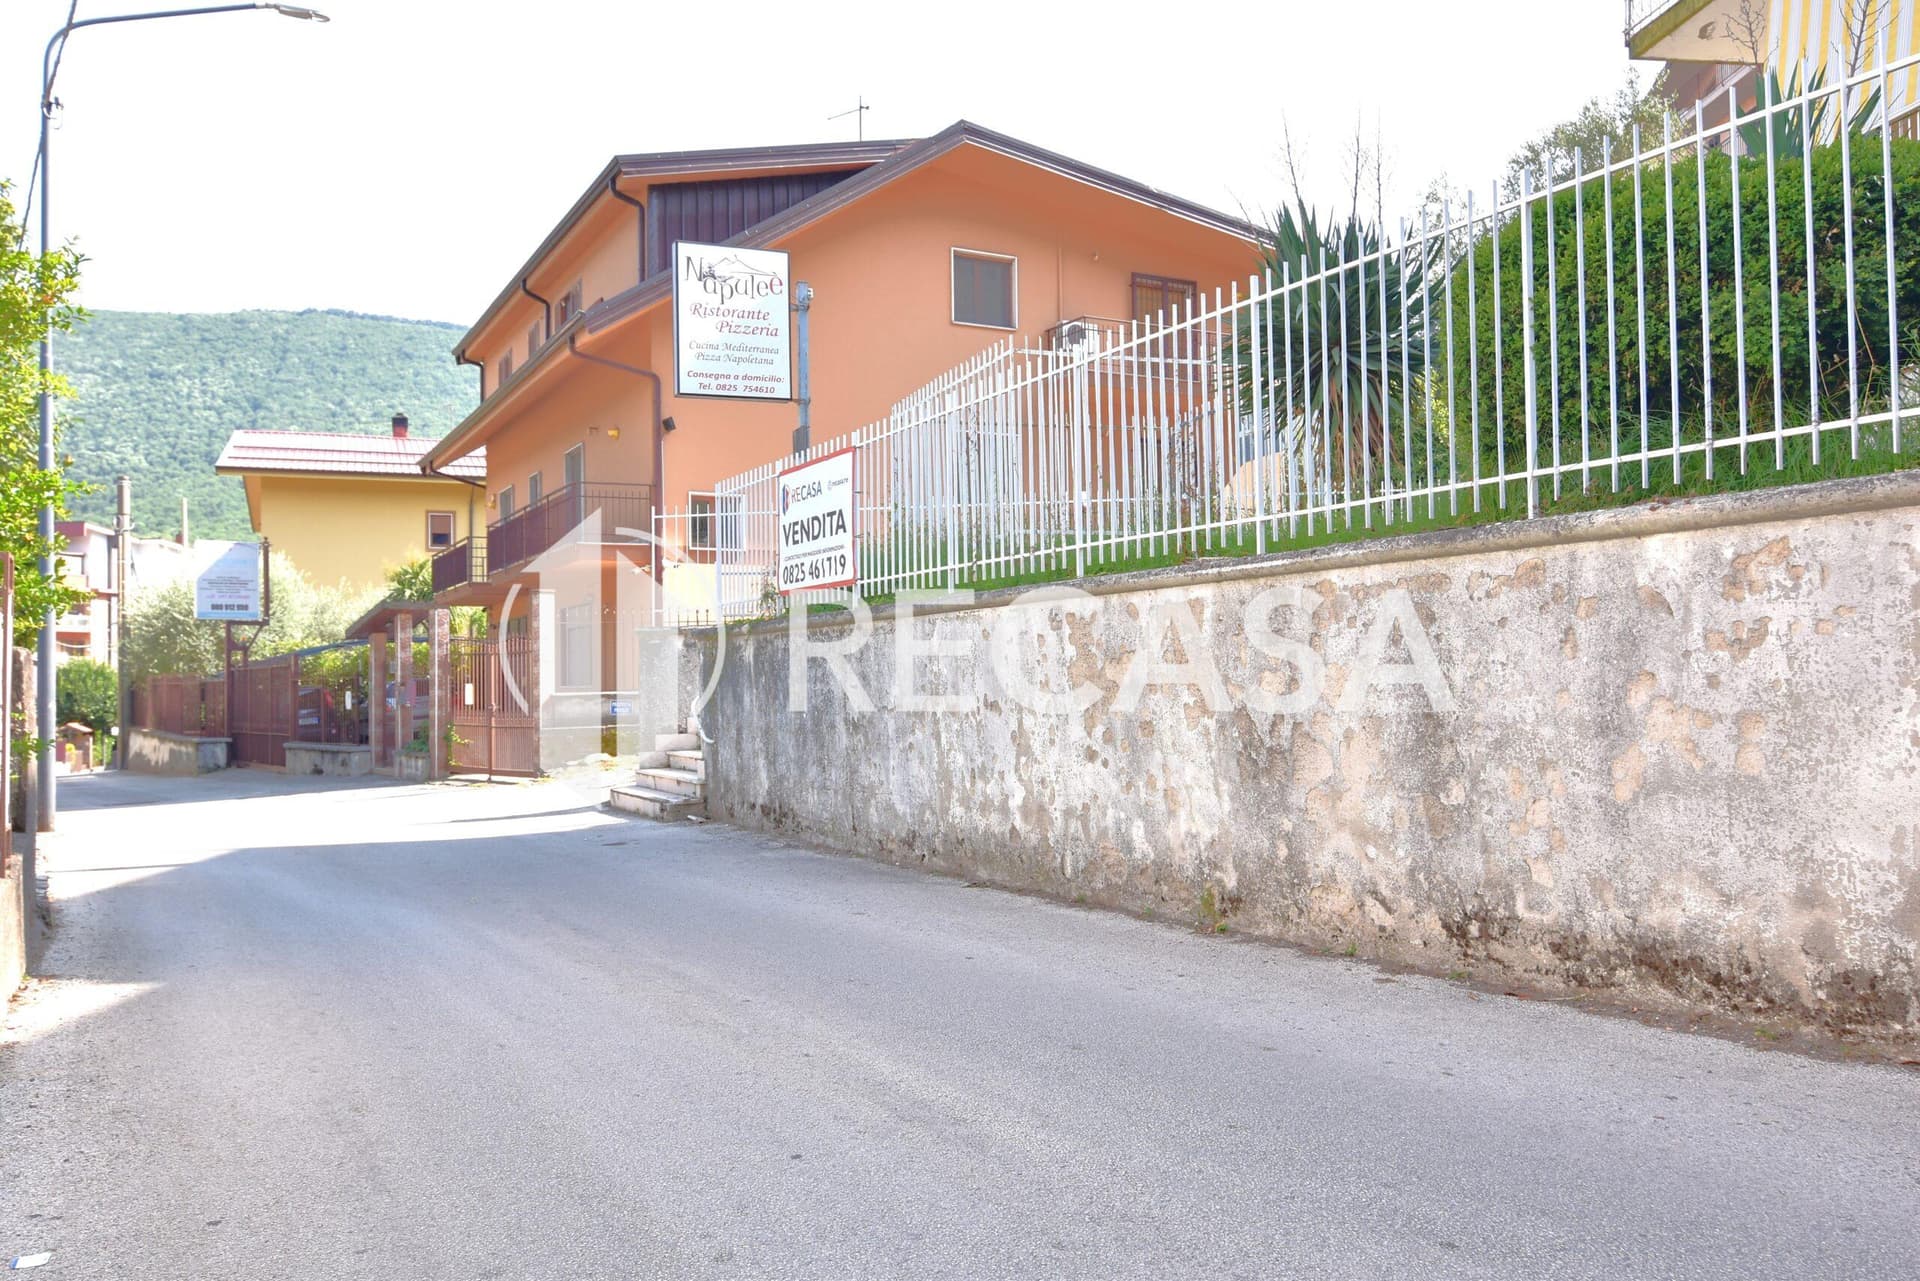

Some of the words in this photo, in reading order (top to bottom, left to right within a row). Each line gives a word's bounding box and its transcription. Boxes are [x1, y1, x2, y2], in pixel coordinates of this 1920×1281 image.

[690, 302, 770, 321] Ristorante
[716, 320, 779, 337] Pizzeria
[689, 340, 719, 351] Cucina
[722, 342, 779, 355] Mediterranea
[695, 351, 721, 362] Pizza
[723, 353, 774, 366] Napoletana
[687, 370, 731, 382] Consegna
[741, 374, 785, 384] domicilio:
[698, 382, 713, 391] Tel.
[716, 383, 738, 392] 0825
[743, 384, 775, 394] 754610
[791, 480, 823, 503] RECASA
[783, 508, 847, 547] VENDITA
[783, 561, 806, 585] 0825
[808, 553, 847, 580] 461719
